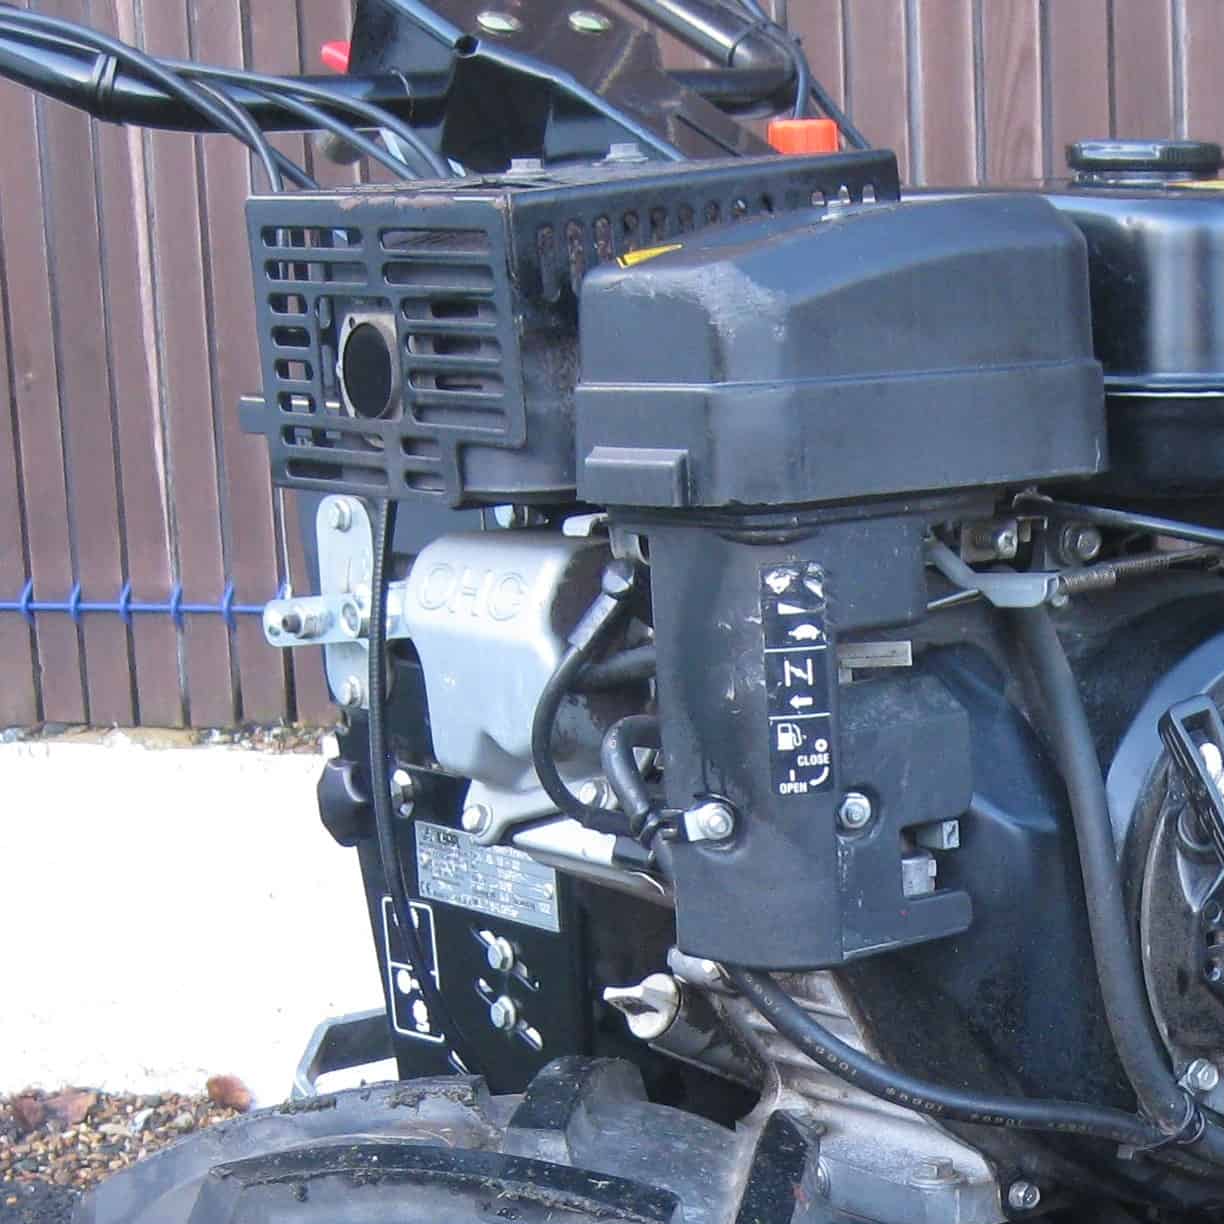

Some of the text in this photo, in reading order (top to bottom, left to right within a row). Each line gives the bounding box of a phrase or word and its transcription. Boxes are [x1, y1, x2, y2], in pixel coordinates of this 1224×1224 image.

[418, 562, 529, 622] OHC
[797, 753, 830, 767] CLOSE
[779, 781, 808, 794] OPEN
